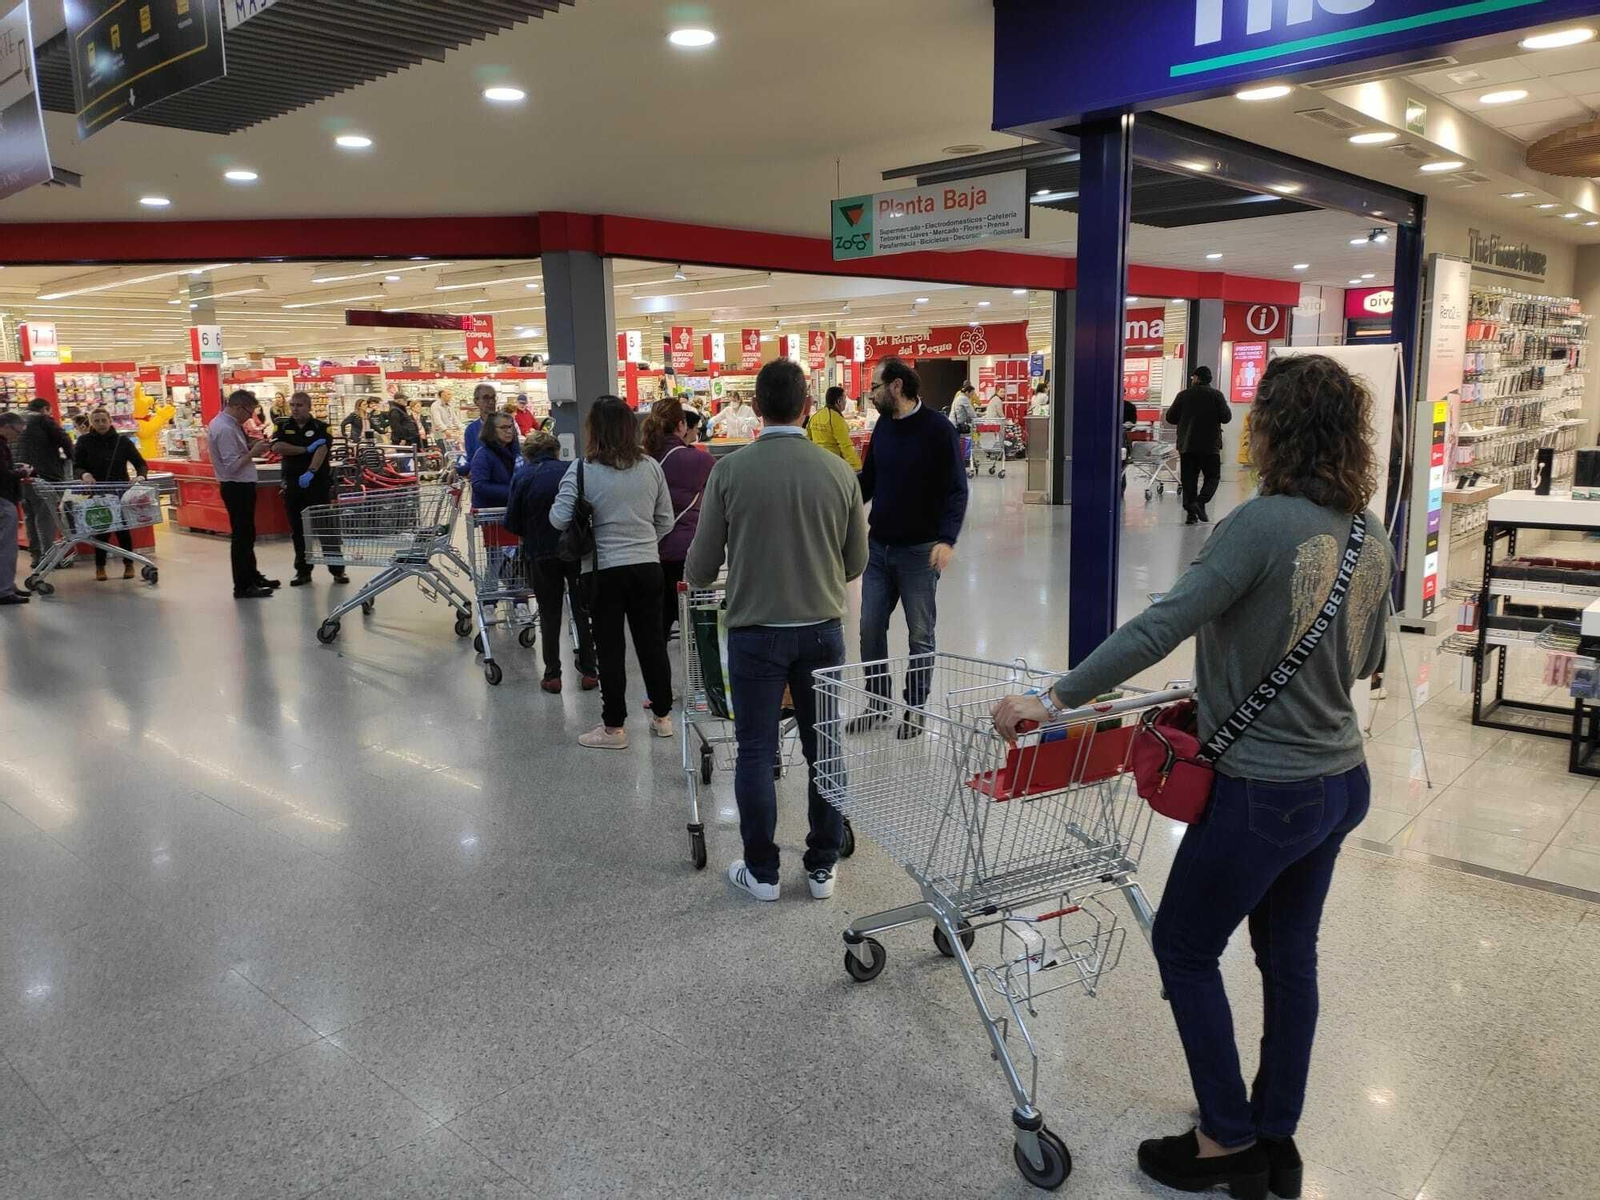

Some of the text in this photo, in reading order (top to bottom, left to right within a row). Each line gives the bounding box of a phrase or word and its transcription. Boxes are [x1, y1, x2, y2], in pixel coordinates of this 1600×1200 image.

[878, 186, 988, 218] Planta Baja
[879, 224, 921, 235] Supermercado
[910, 231, 928, 239] Llaves
[932, 226, 959, 236] Mercado
[879, 240, 916, 250] Parafarmacia
[920, 236, 949, 245] Bicicletas
[32, 329, 38, 344] 7
[201, 333, 209, 346] 6
[876, 334, 888, 346] El
[898, 343, 952, 356] del Peque
[1207, 726, 1235, 754] MY
[1229, 683, 1277, 731] LIFE'S
[1270, 617, 1329, 686] GETTING
[1323, 547, 1361, 617] BETTER.
[1351, 514, 1366, 543] MY
